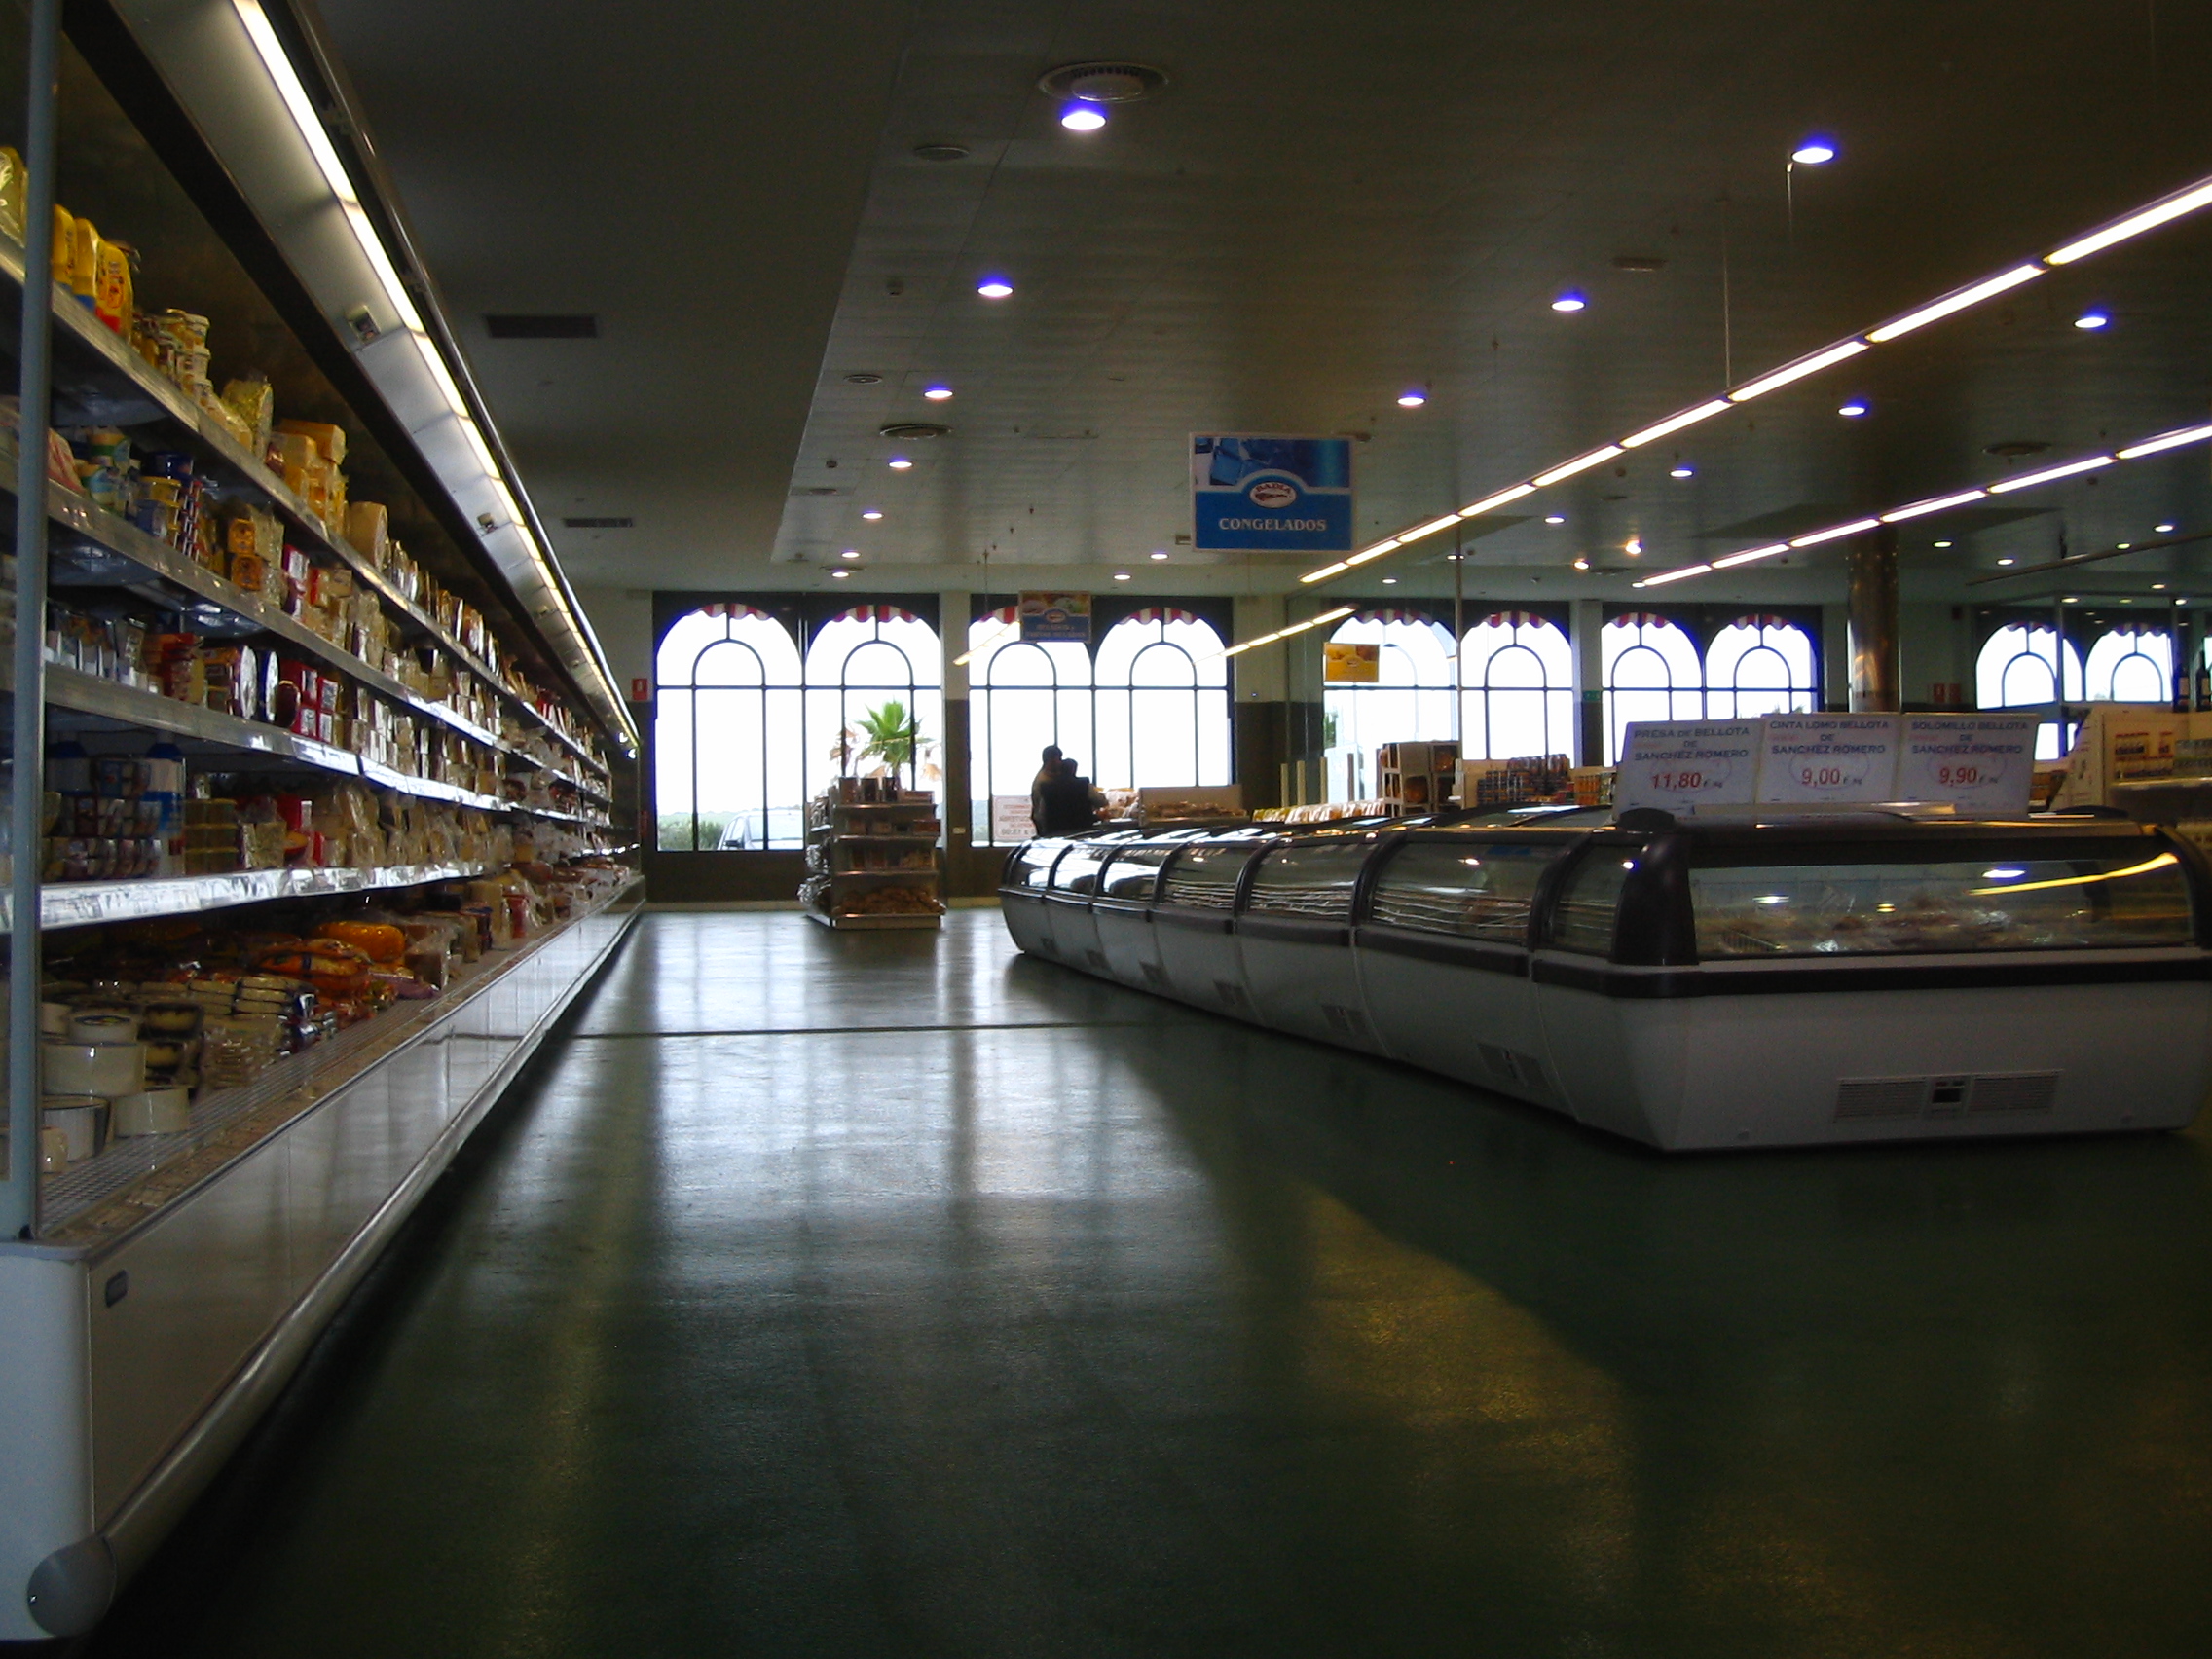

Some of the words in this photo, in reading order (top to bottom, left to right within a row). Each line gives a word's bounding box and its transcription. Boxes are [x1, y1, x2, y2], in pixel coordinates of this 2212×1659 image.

[1219, 518, 1327, 532] CONGELADOS
[1770, 720, 1802, 729] CINTA
[1839, 720, 1889, 729] BELLOTA
[1911, 721, 1976, 730] SOLOMILLO
[1977, 721, 2029, 730] BELLOTA
[1635, 729, 1674, 738] PRESA
[1694, 727, 1750, 736] BELLOTA
[1695, 749, 1749, 758] ROMERO
[1833, 745, 1886, 754] ROMERO
[1970, 745, 2022, 754] ROMERO
[1651, 772, 1702, 790] 11,80
[1801, 768, 1840, 788] 9,00
[1939, 767, 1977, 787] 9,90
